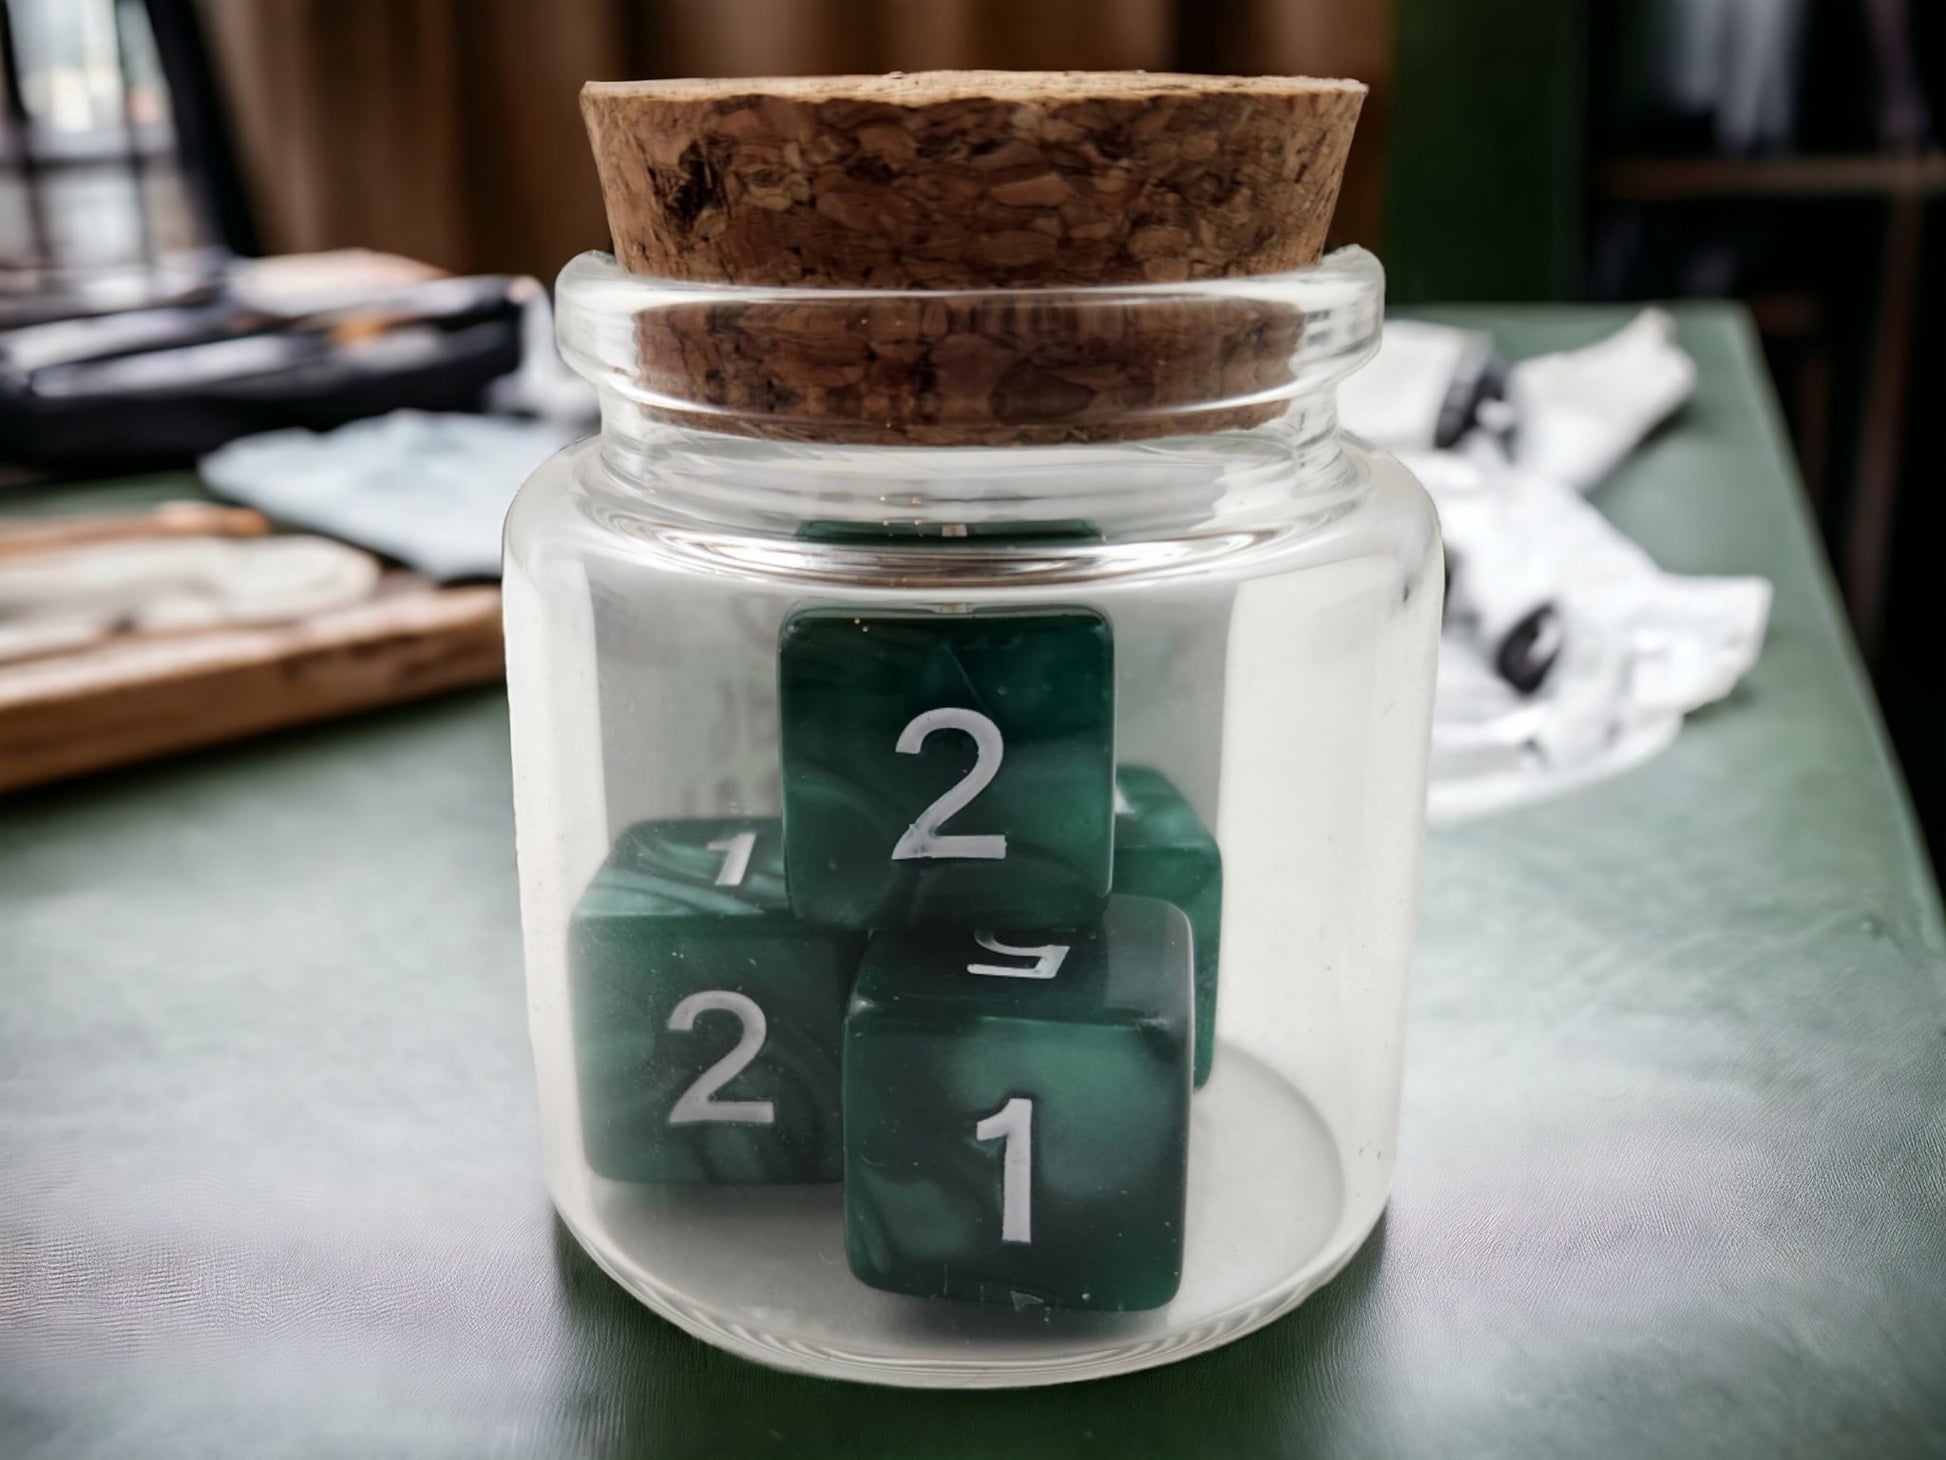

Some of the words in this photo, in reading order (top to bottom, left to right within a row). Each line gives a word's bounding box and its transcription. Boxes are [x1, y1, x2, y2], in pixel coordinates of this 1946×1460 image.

[892, 707, 1006, 860] 2
[707, 833, 756, 886] 1
[667, 990, 775, 1125] 2
[976, 1098, 1033, 1243] 1
